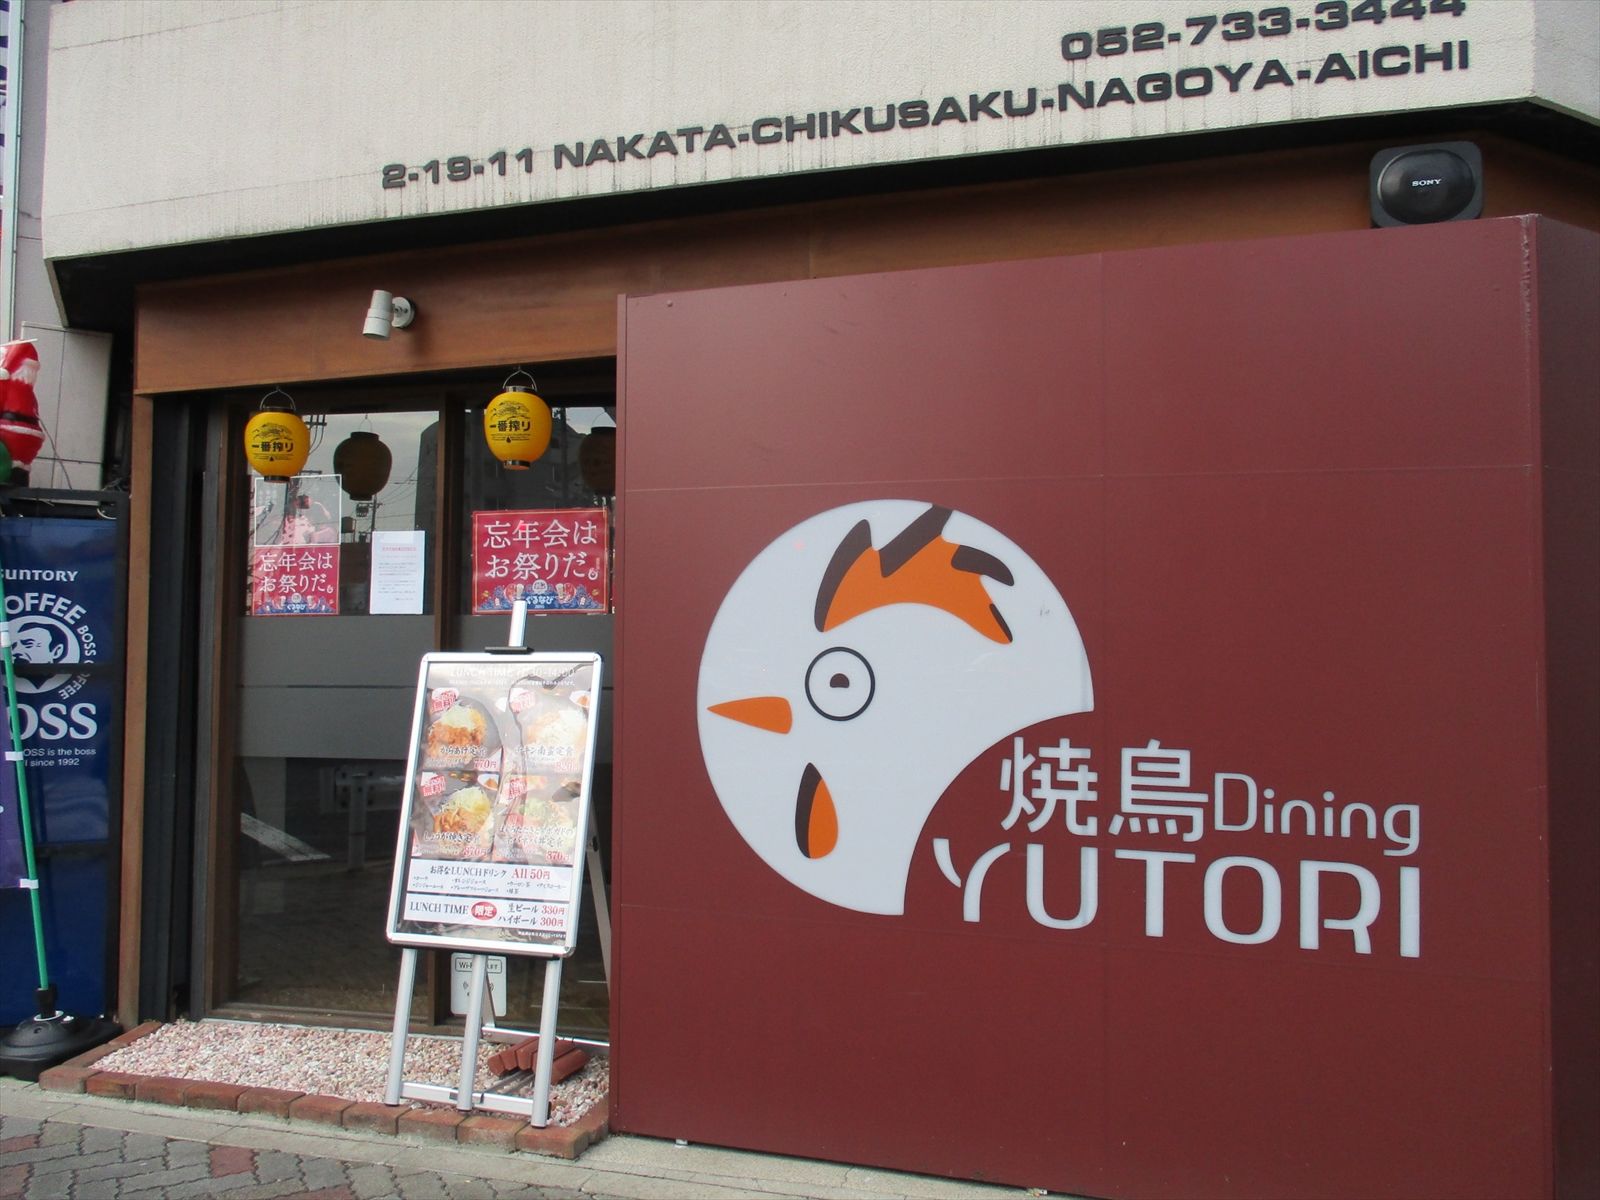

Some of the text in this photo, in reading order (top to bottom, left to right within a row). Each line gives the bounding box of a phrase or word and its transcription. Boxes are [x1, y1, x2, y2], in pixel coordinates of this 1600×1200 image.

[382, 40, 1469, 189] 2-19-11 NAKATA-CHIKUSAKU-NAGOYA-AICHI
[1412, 179, 1442, 187] SONY
[490, 420, 531, 432] 一番搾り
[251, 441, 295, 453] 一番搾り
[483, 519, 598, 550] 忘年会は
[258, 551, 334, 573] 忘年会は
[525, 595, 554, 605] ぐるなび
[4, 592, 87, 625] OFFEE
[76, 624, 97, 657] BOSS
[6, 702, 98, 740] OSS
[23, 747, 97, 757] OSS is the boss
[58, 757, 80, 766] 1992
[512, 868, 529, 880] All
[531, 868, 551, 881] 50円
[933, 838, 1420, 958] YUTORI
[409, 902, 468, 916] LUNCH TIME
[473, 907, 494, 917] 限定
[508, 903, 539, 914] 生ビール
[499, 914, 564, 927] ハイボール 300円
